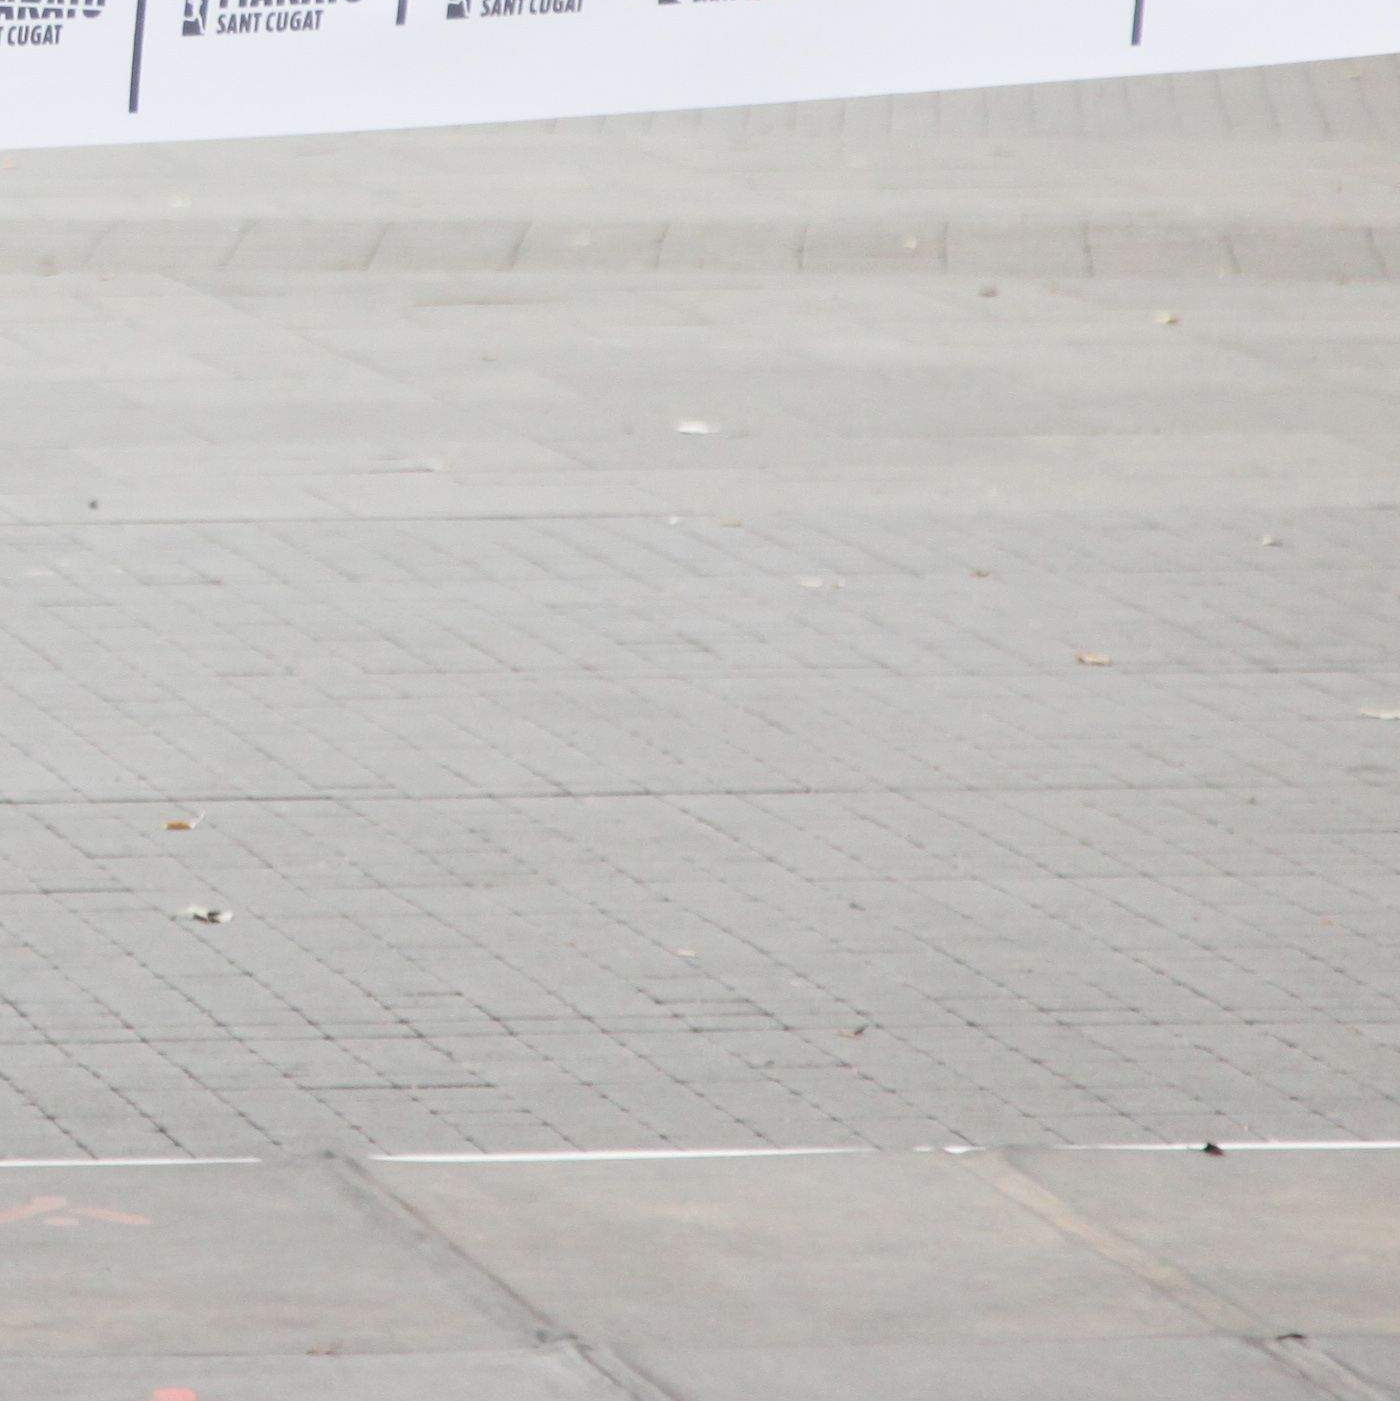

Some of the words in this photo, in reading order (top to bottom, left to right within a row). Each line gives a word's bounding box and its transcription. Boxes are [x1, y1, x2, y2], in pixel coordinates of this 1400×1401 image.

[216, 12, 263, 33] SANT
[265, 10, 323, 31] CUGAT
[7, 24, 62, 46] CUGAT
